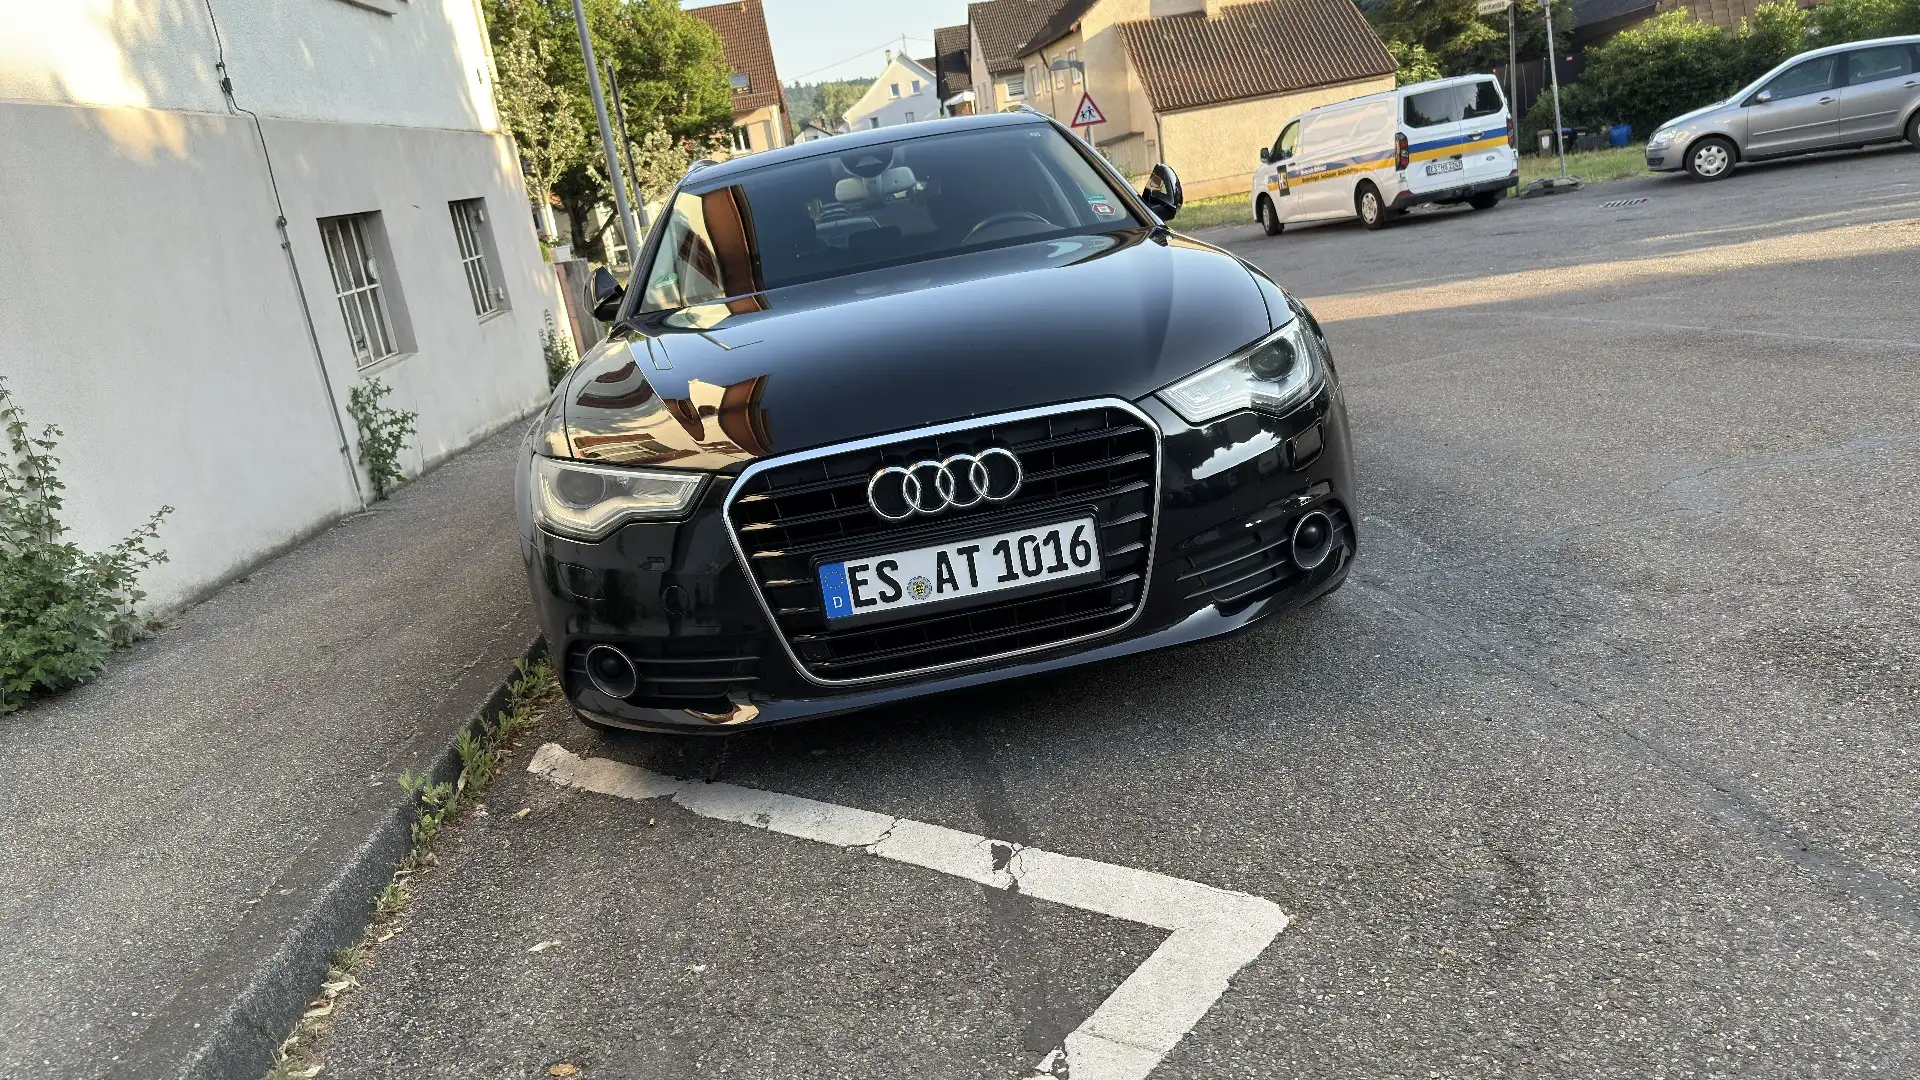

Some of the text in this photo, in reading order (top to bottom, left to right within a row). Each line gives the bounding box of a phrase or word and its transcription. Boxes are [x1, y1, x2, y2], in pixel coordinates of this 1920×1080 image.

[847, 559, 903, 608] ES
[936, 544, 980, 594] AT
[992, 524, 1092, 583] 1016
[833, 596, 844, 609] D
